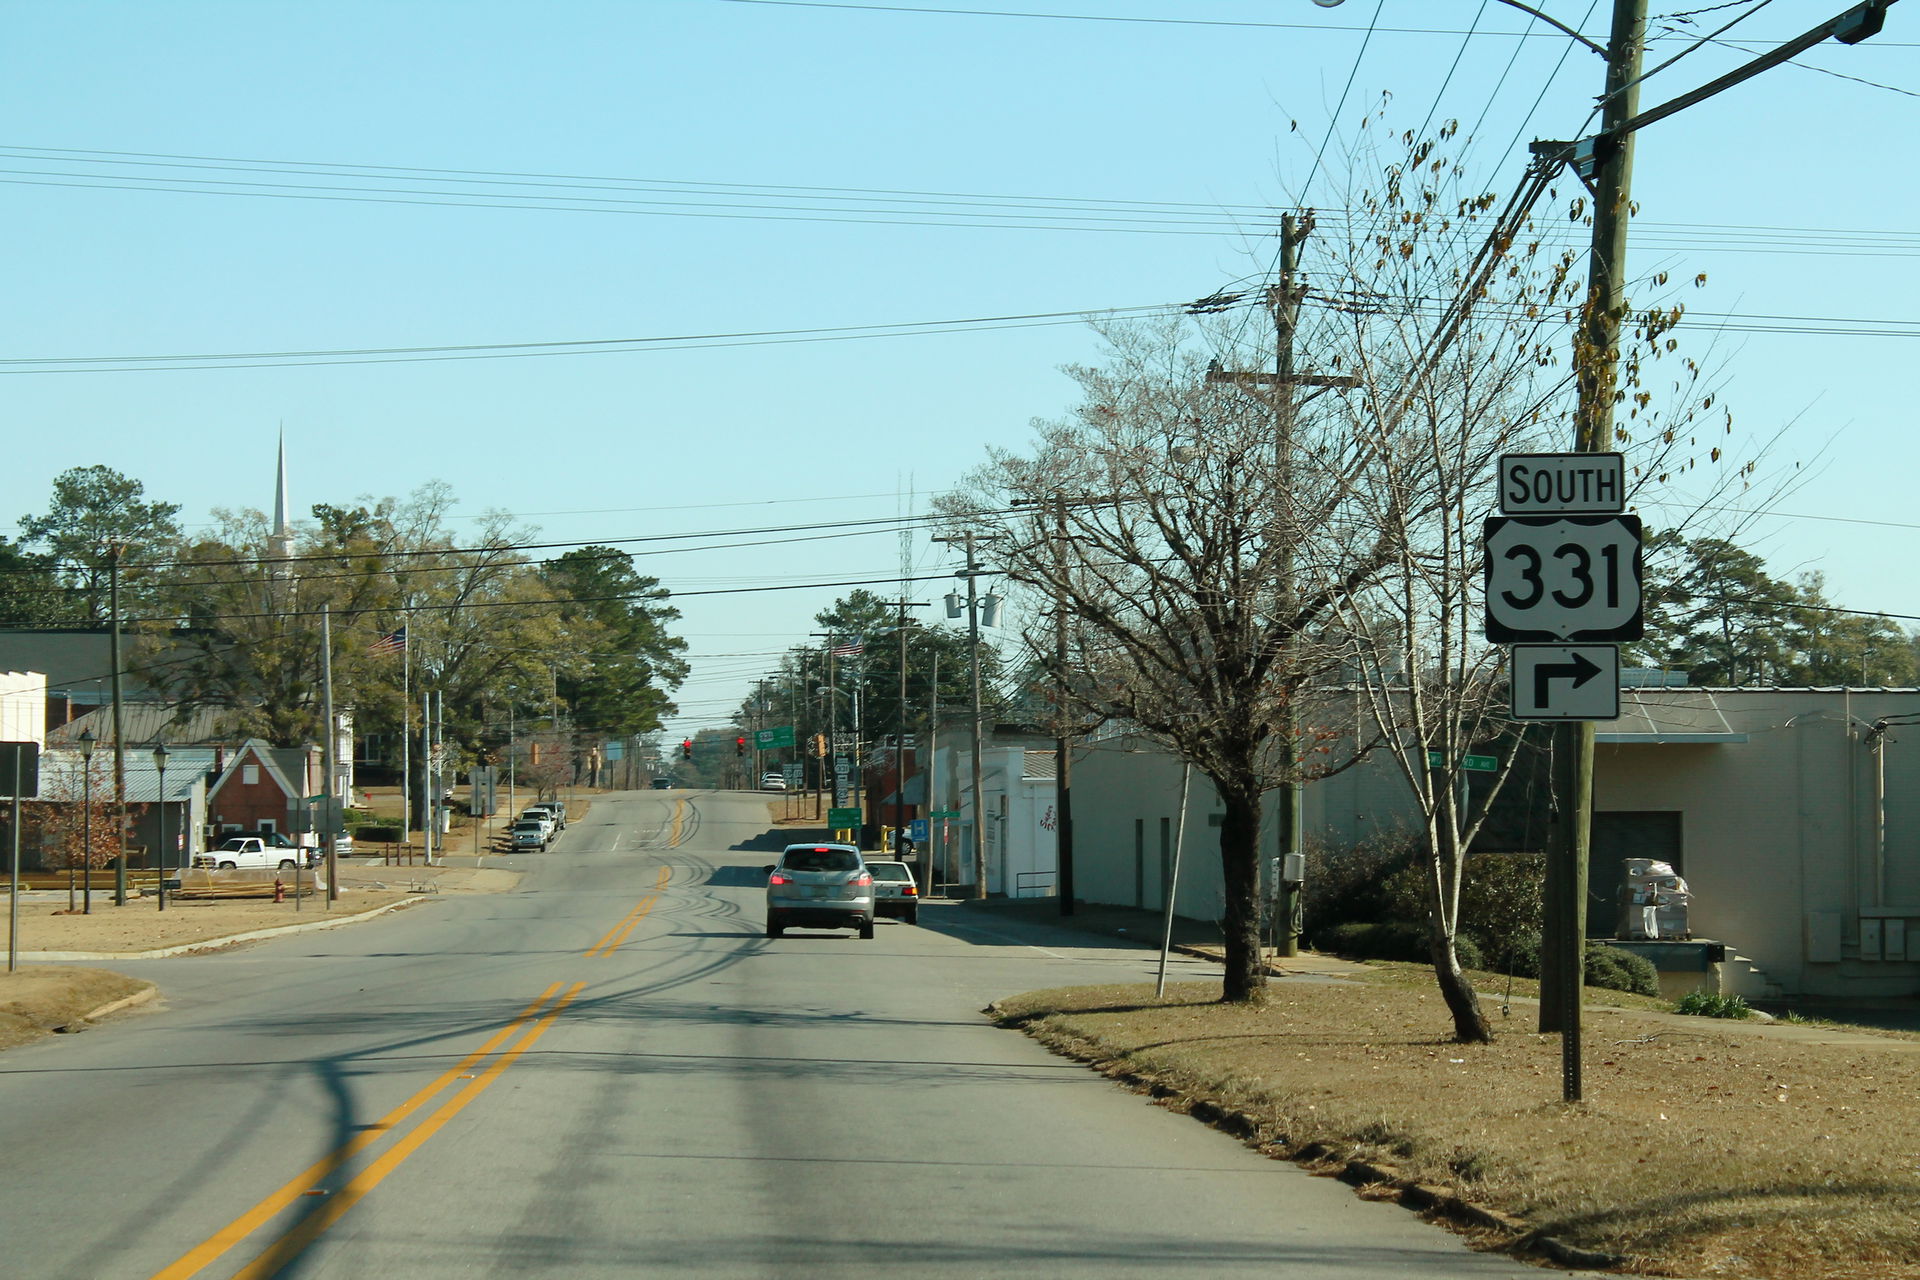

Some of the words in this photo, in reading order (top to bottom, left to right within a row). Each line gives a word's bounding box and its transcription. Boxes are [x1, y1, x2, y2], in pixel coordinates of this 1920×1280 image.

[1509, 464, 1616, 504] SOUTH
[1501, 542, 1619, 611] 331
[914, 821, 925, 835] H
